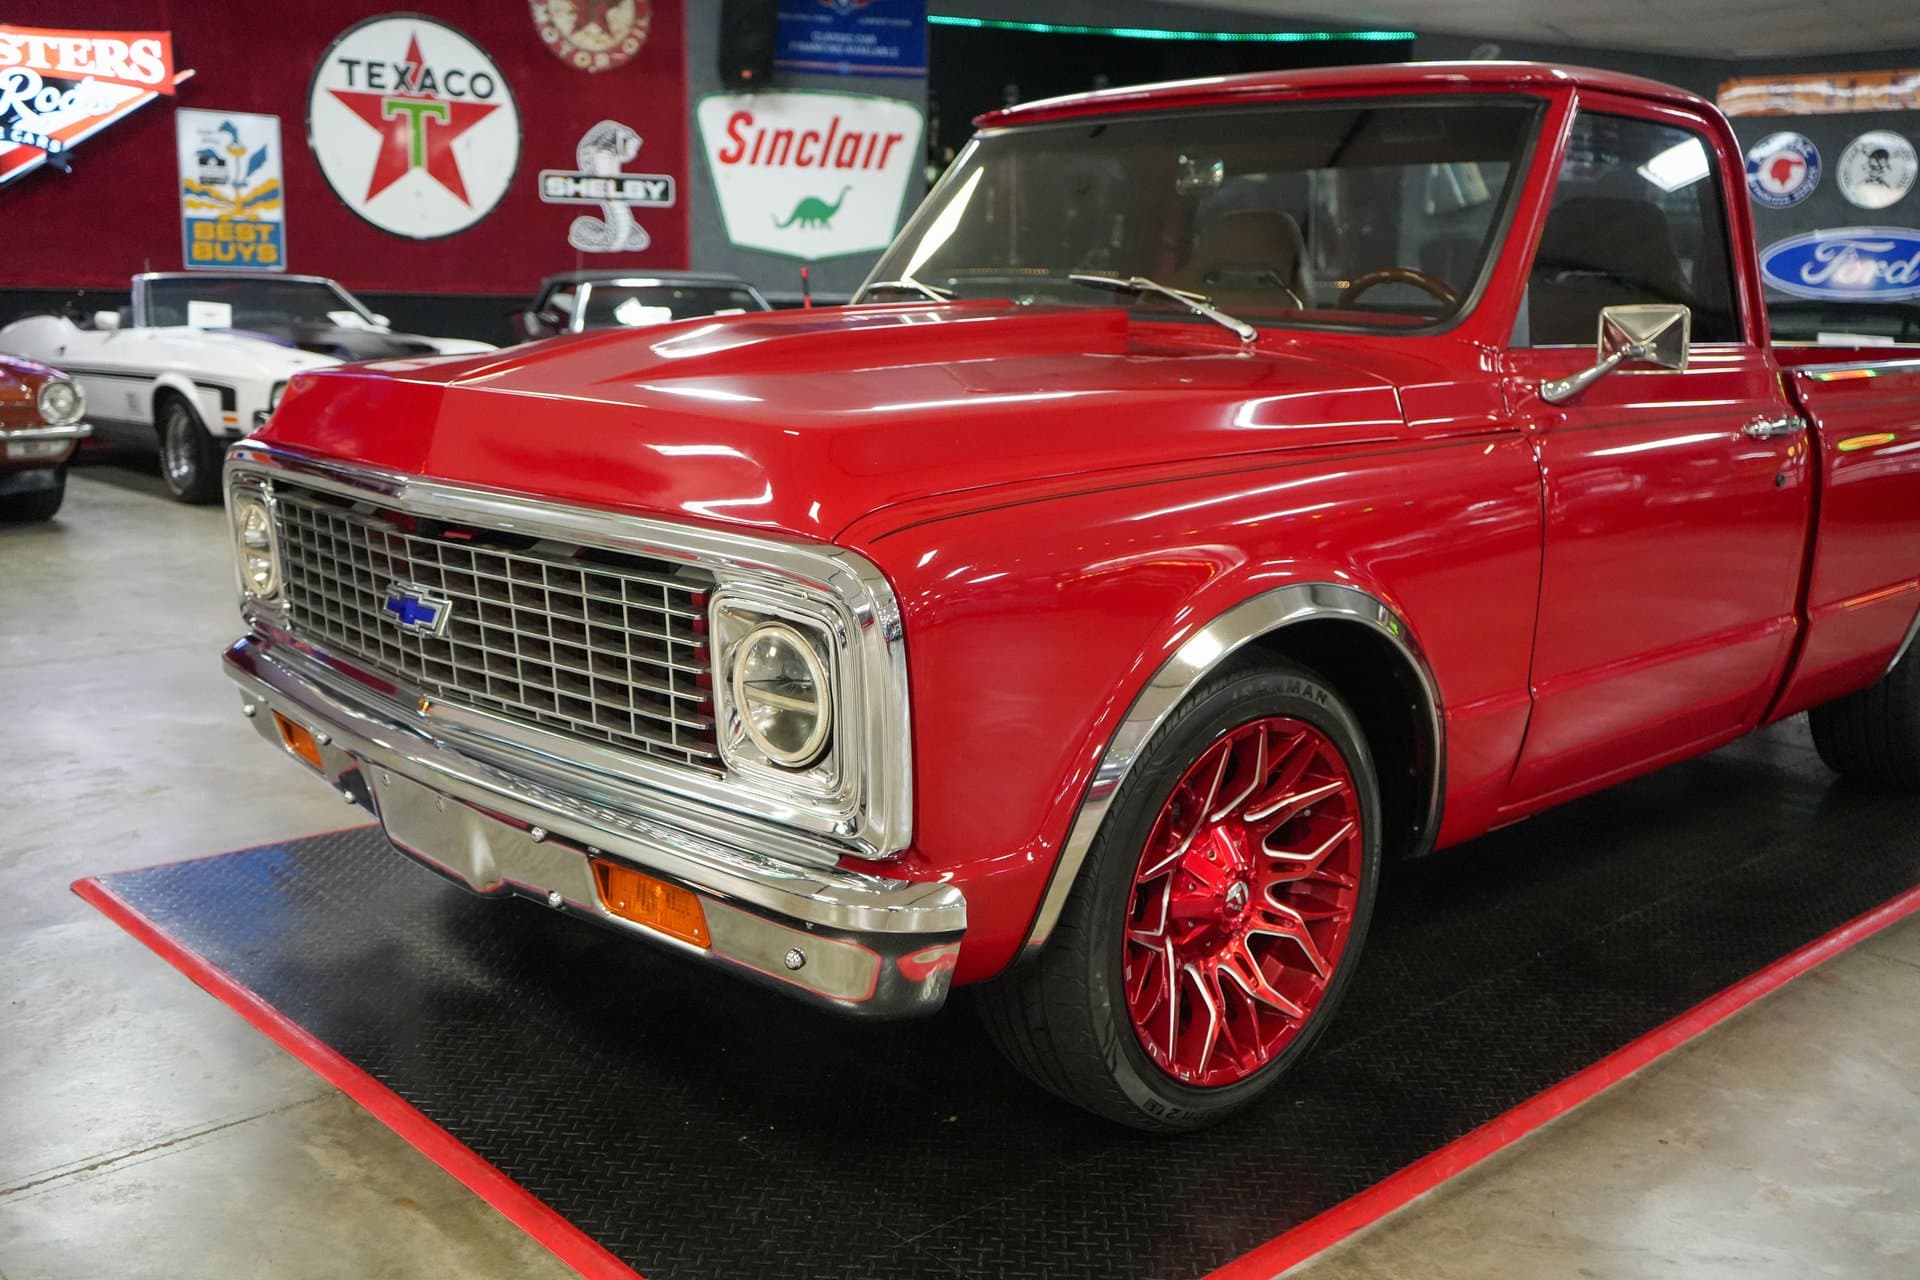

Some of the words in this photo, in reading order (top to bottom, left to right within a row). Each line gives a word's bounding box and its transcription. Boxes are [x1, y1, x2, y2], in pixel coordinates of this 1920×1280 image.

[338, 58, 494, 99] TEXACO
[719, 111, 903, 170] Sinclair
[544, 175, 667, 200] SHELBY
[193, 221, 274, 243] BEST
[192, 241, 278, 263] BUYS
[1801, 238, 1920, 285] Ford
